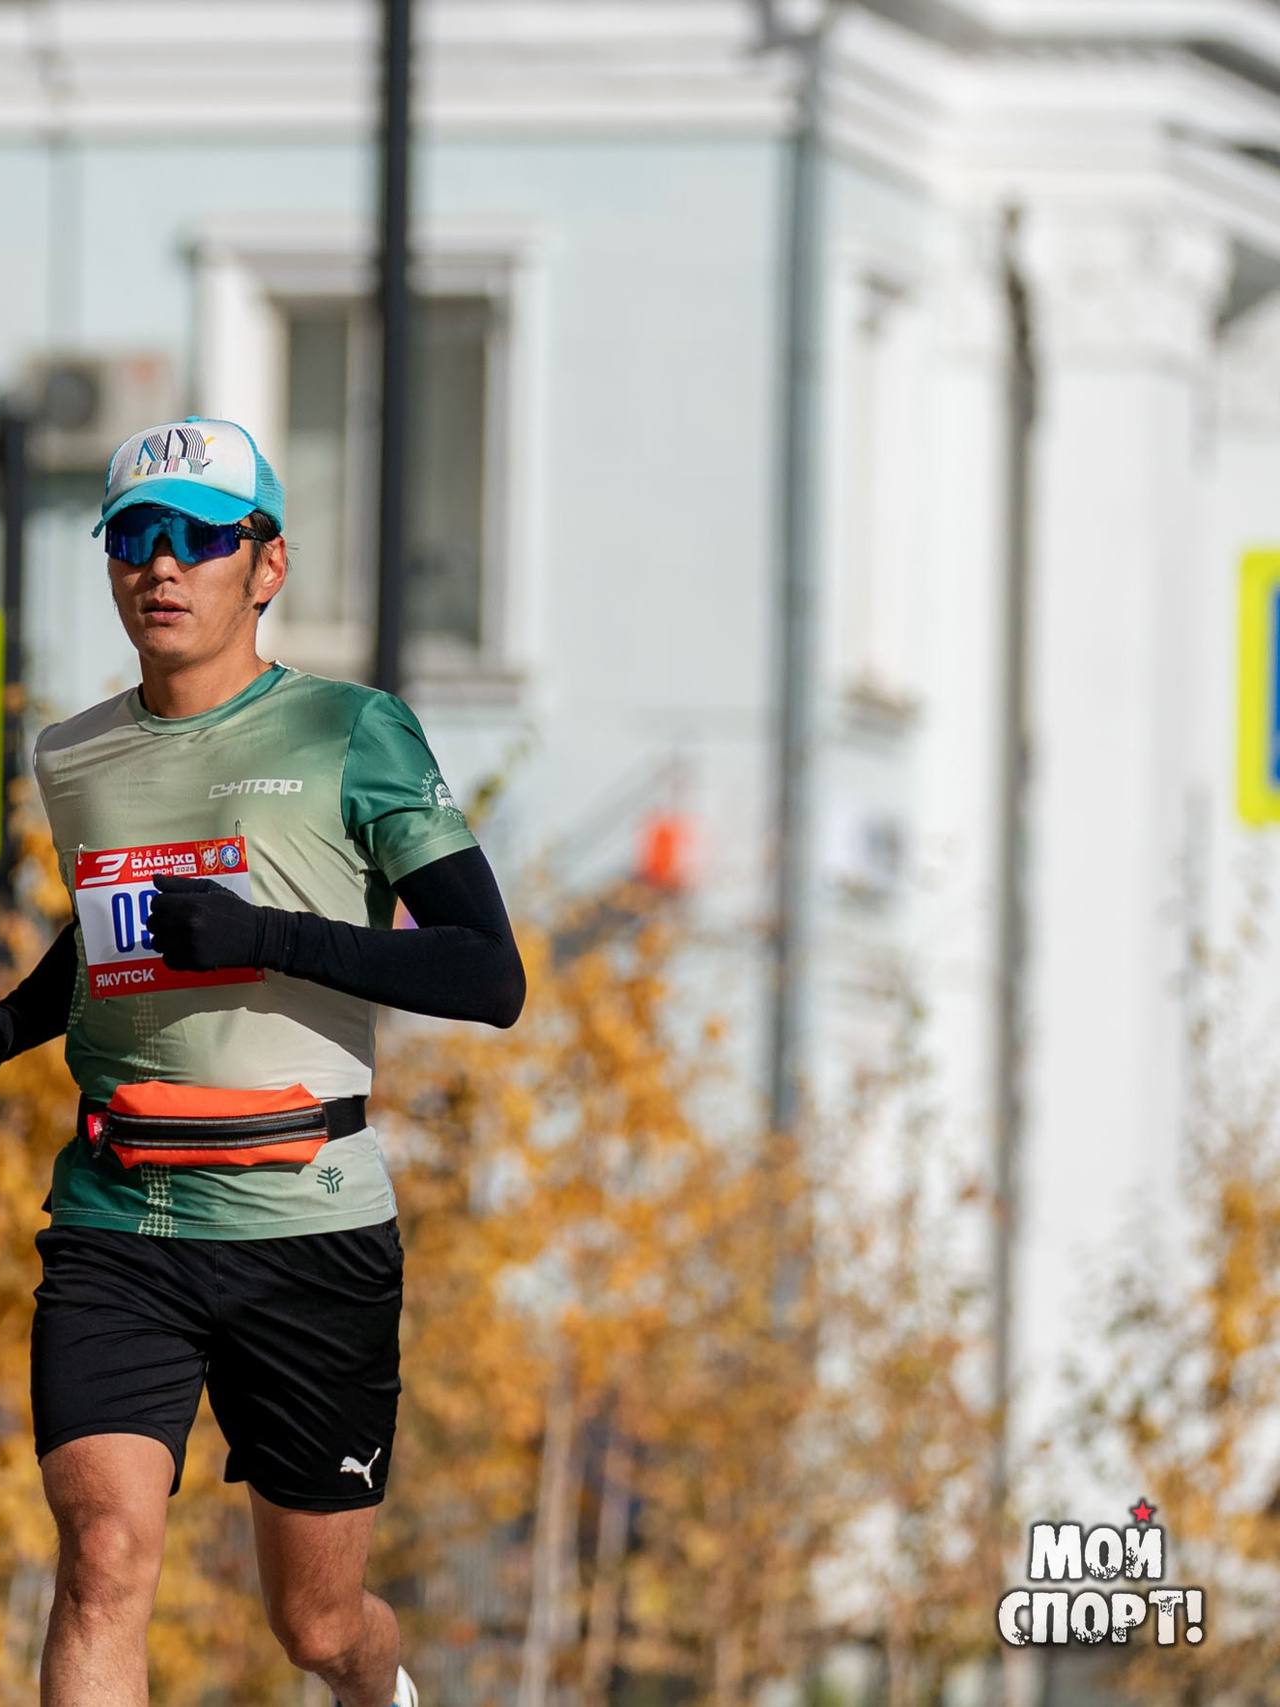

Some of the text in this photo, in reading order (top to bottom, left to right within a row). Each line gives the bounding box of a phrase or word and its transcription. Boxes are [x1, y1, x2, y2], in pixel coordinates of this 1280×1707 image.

[131, 848, 173, 859] ЗАБЕГ
[131, 853, 196, 869] ОЛОНХО
[132, 867, 173, 878] МАРАФОН
[95, 968, 155, 988] ЯКУТСК
